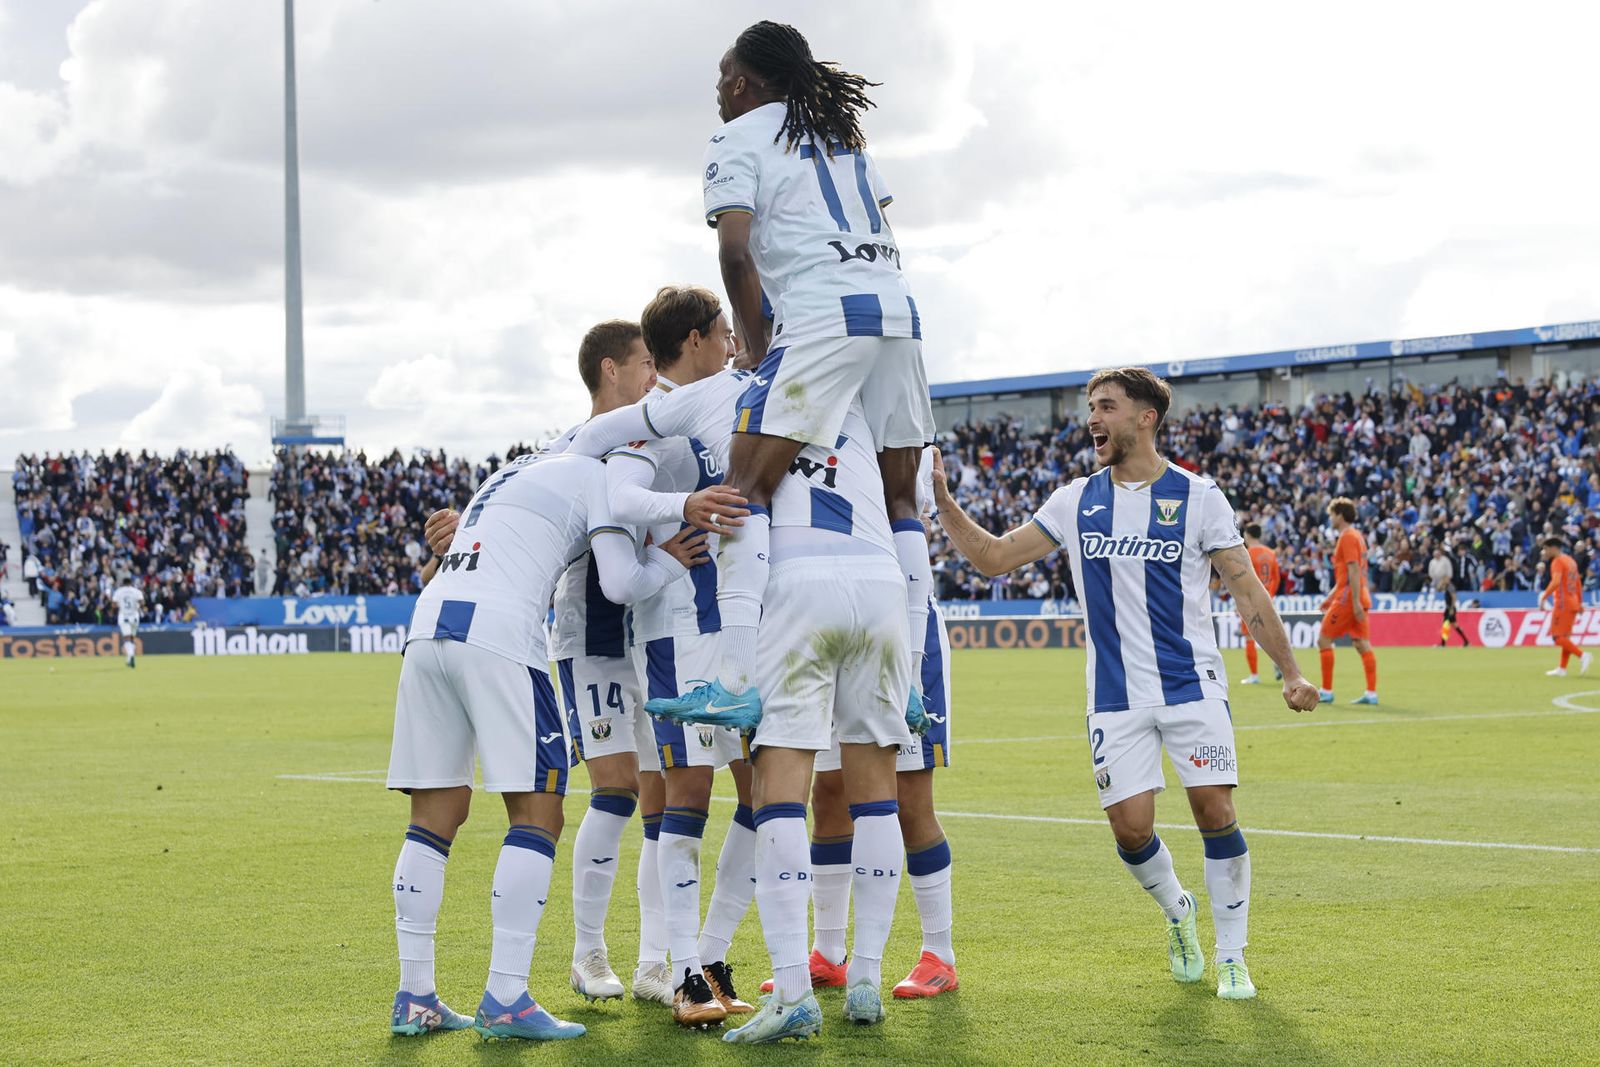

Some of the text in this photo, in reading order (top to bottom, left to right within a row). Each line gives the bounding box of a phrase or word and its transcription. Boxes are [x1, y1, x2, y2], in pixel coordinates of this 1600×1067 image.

[1081, 532, 1182, 563] Ontime
[283, 596, 368, 624] Lowi
[192, 627, 309, 655] Mahou
[994, 620, 1049, 648] 0.0
[587, 681, 625, 716] 14
[1092, 728, 1106, 766] 2
[1194, 746, 1233, 759] URBAN
[1210, 758, 1237, 772] POKE
